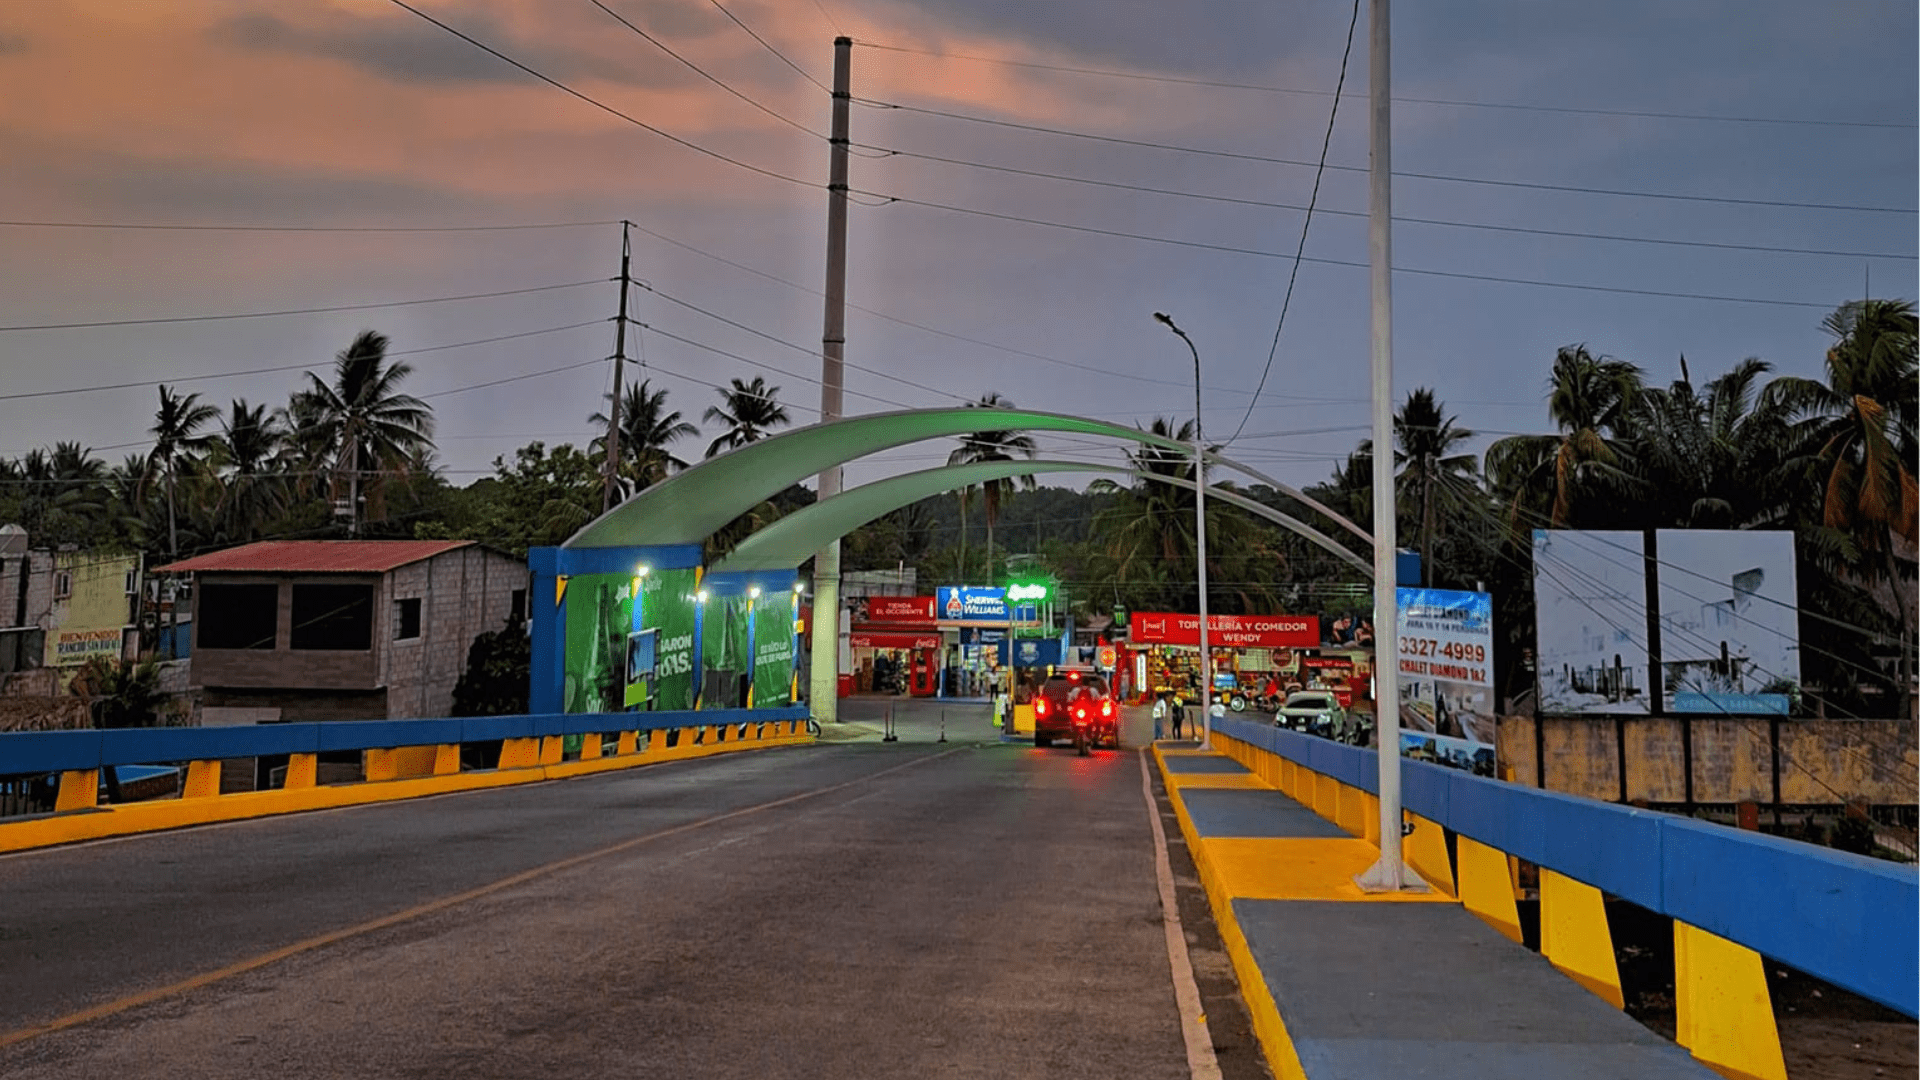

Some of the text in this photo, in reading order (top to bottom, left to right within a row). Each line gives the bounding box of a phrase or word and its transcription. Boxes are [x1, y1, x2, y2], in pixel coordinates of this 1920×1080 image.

[876, 608, 884, 616] EL
[1178, 619, 1307, 632] TORLLERÍA Y COMEDOR
[1223, 633, 1261, 642] WENDY
[1399, 636, 1486, 662] 3327-4999
[1399, 659, 1428, 675] CHALET
[1430, 662, 1468, 680] DIAMOND
